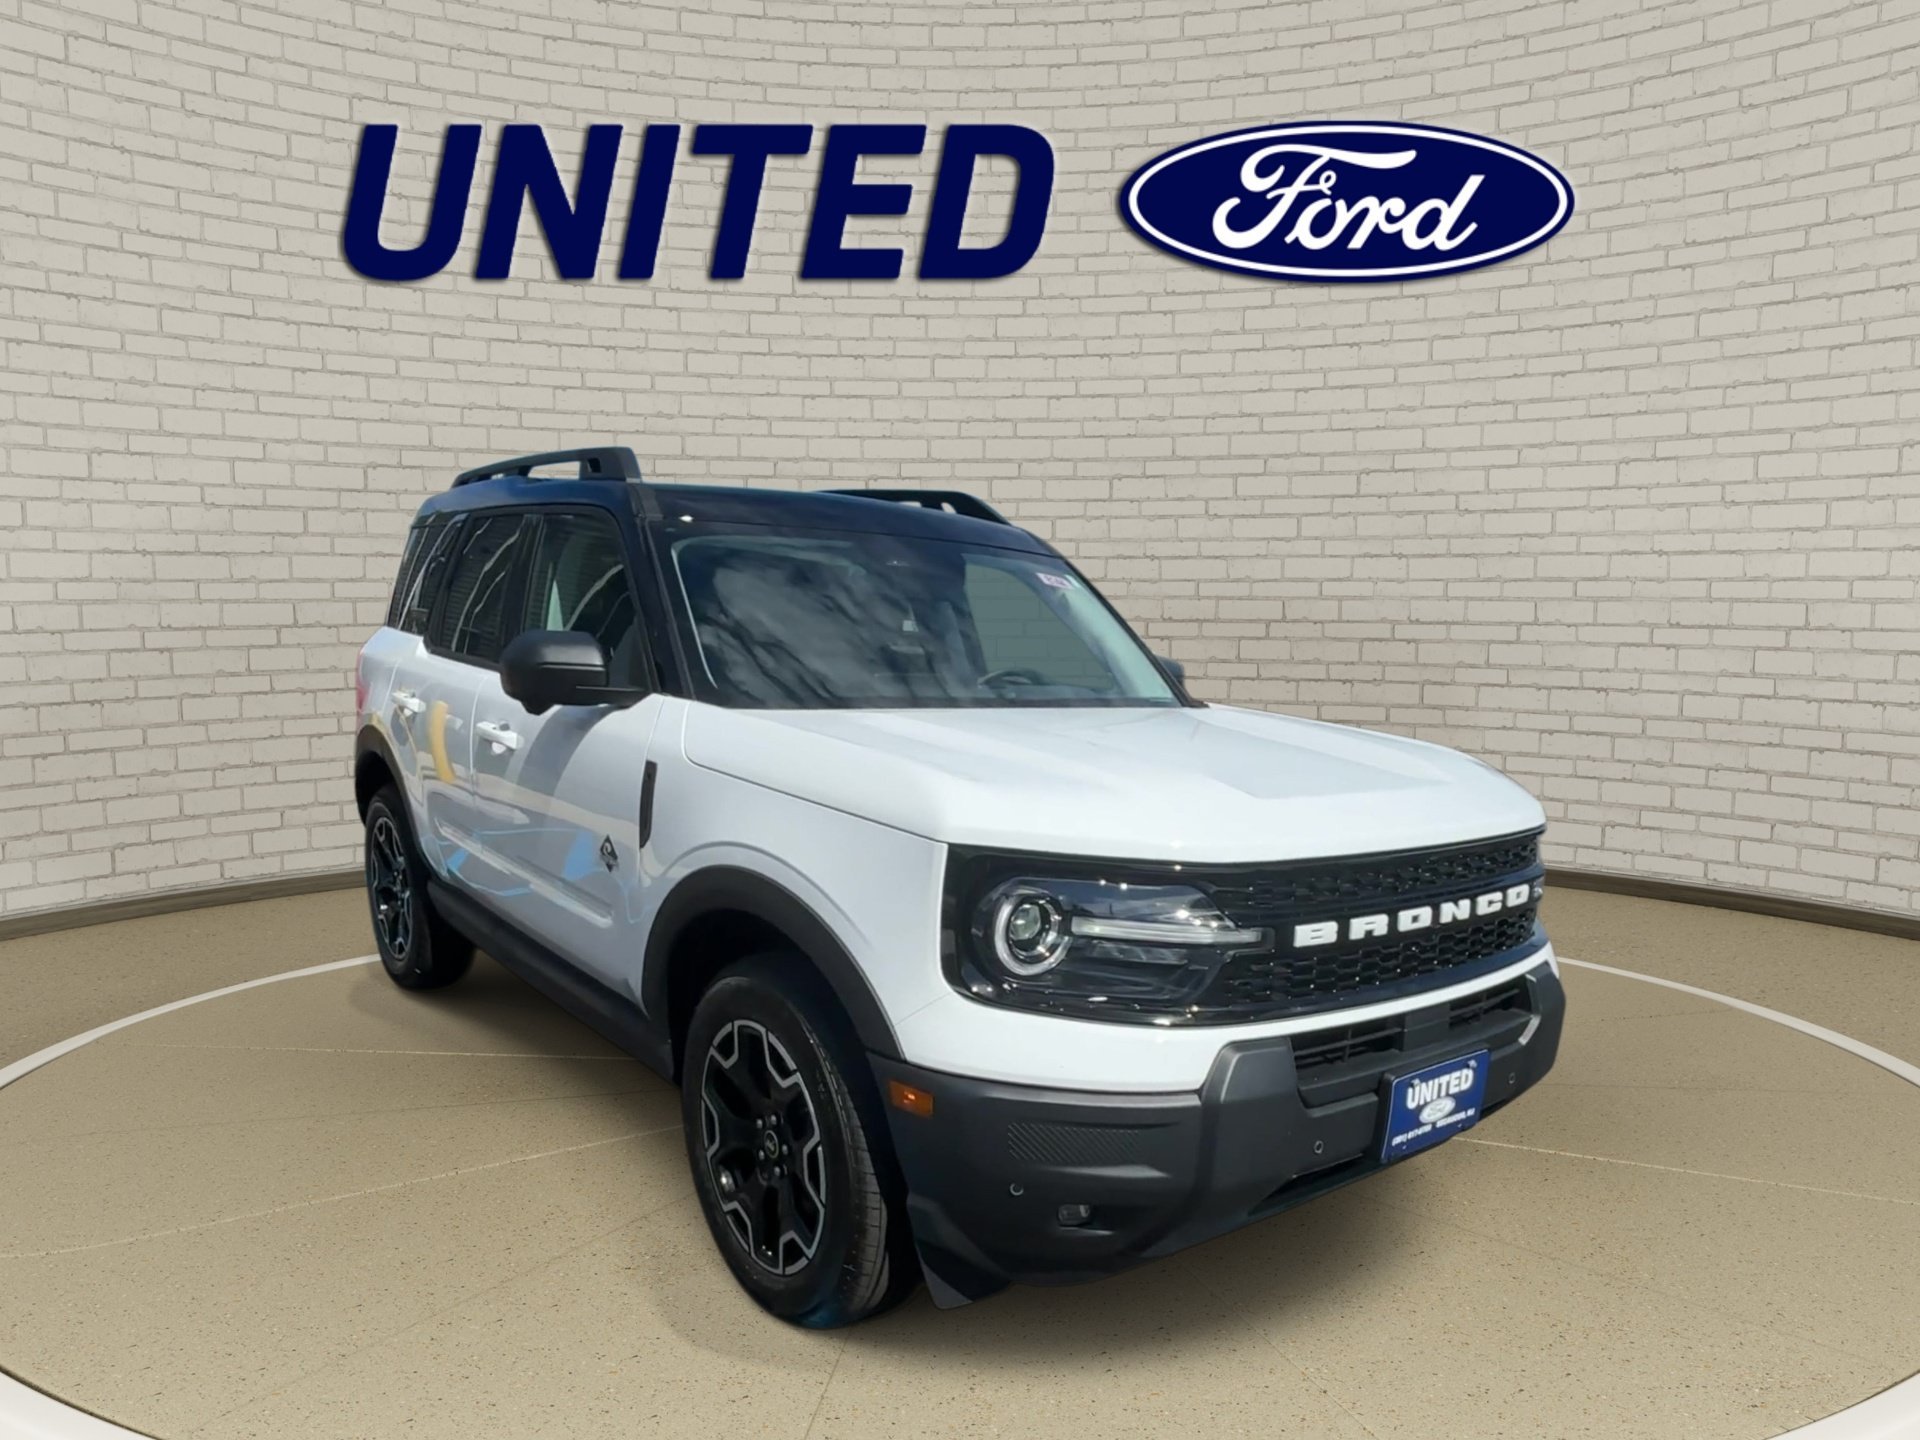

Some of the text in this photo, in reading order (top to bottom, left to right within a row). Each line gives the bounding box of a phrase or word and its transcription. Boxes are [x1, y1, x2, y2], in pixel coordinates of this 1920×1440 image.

[343, 125, 1486, 280] UNITED Ford
[1292, 883, 1531, 948] BRONCO
[1406, 1068, 1475, 1110] UNITED
